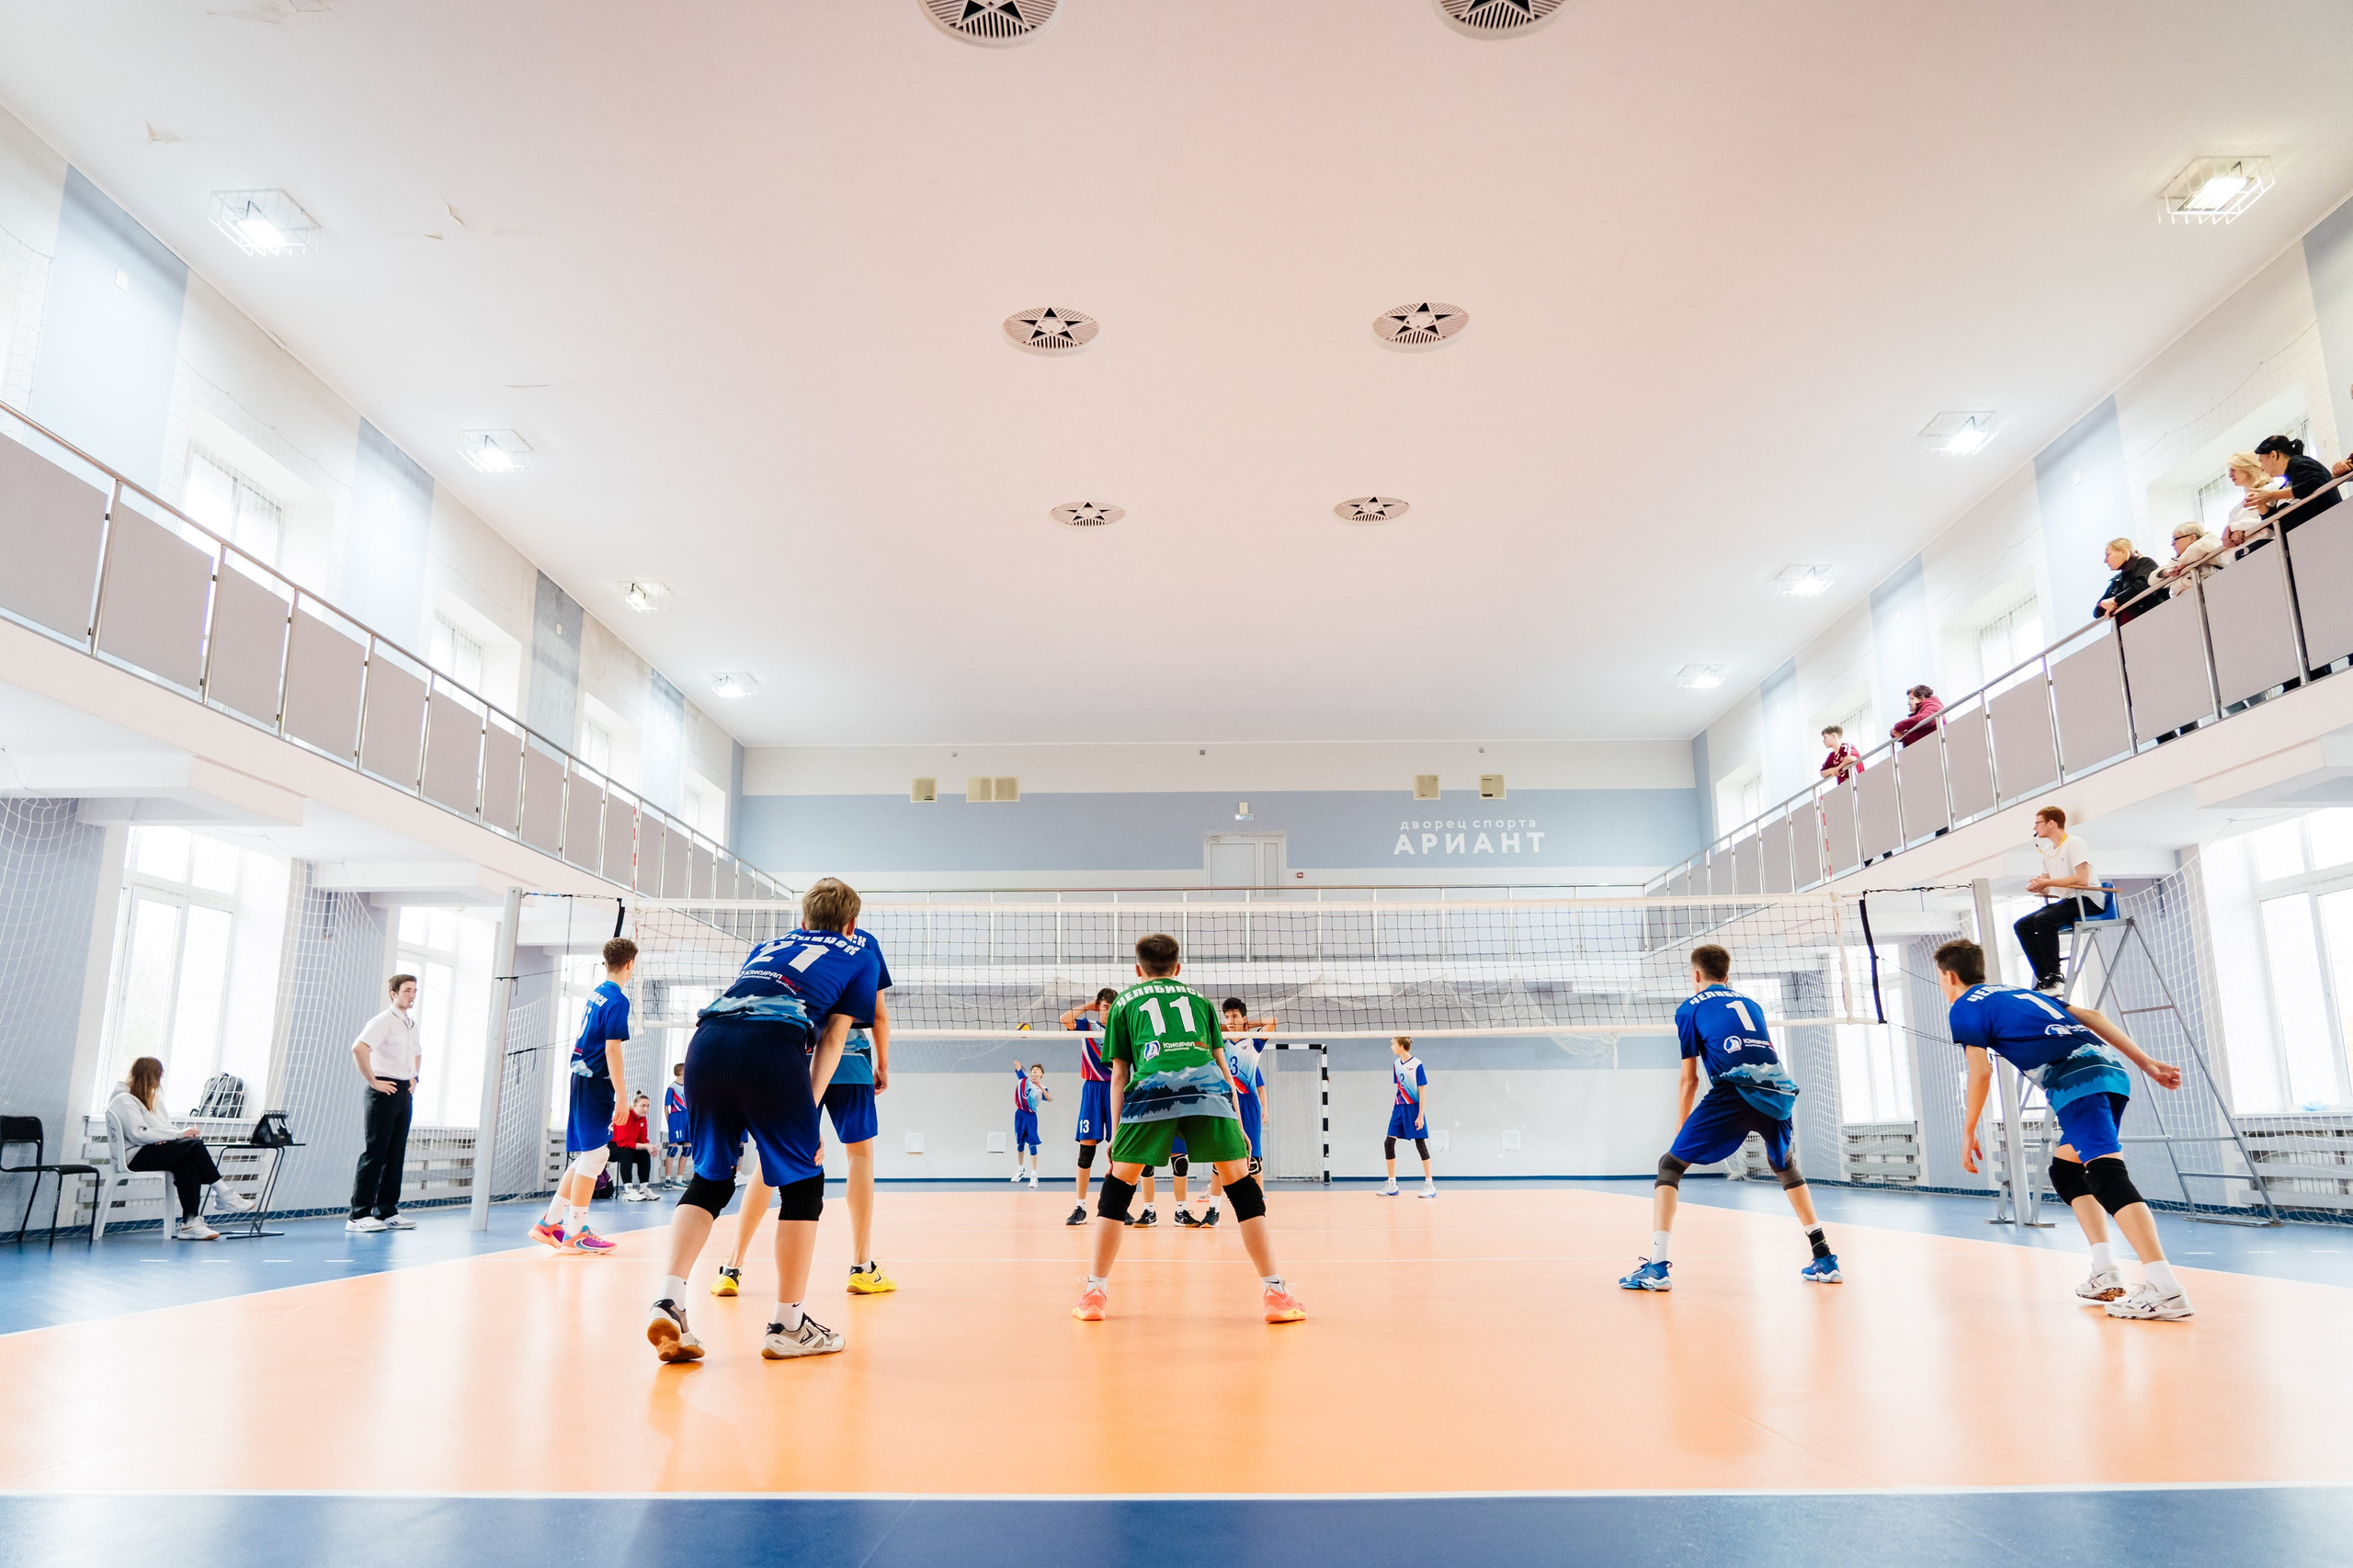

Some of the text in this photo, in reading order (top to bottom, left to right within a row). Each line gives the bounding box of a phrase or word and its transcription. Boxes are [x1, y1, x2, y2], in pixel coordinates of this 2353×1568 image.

[1400, 819, 1537, 831] дворец спорта
[1392, 832, 1545, 855] АРИАНТ
[743, 940, 830, 972] 21
[1139, 995, 1197, 1037] 11
[1725, 1000, 1756, 1031] 1
[2012, 993, 2065, 1020] 1
[1079, 1119, 1090, 1133] 13
